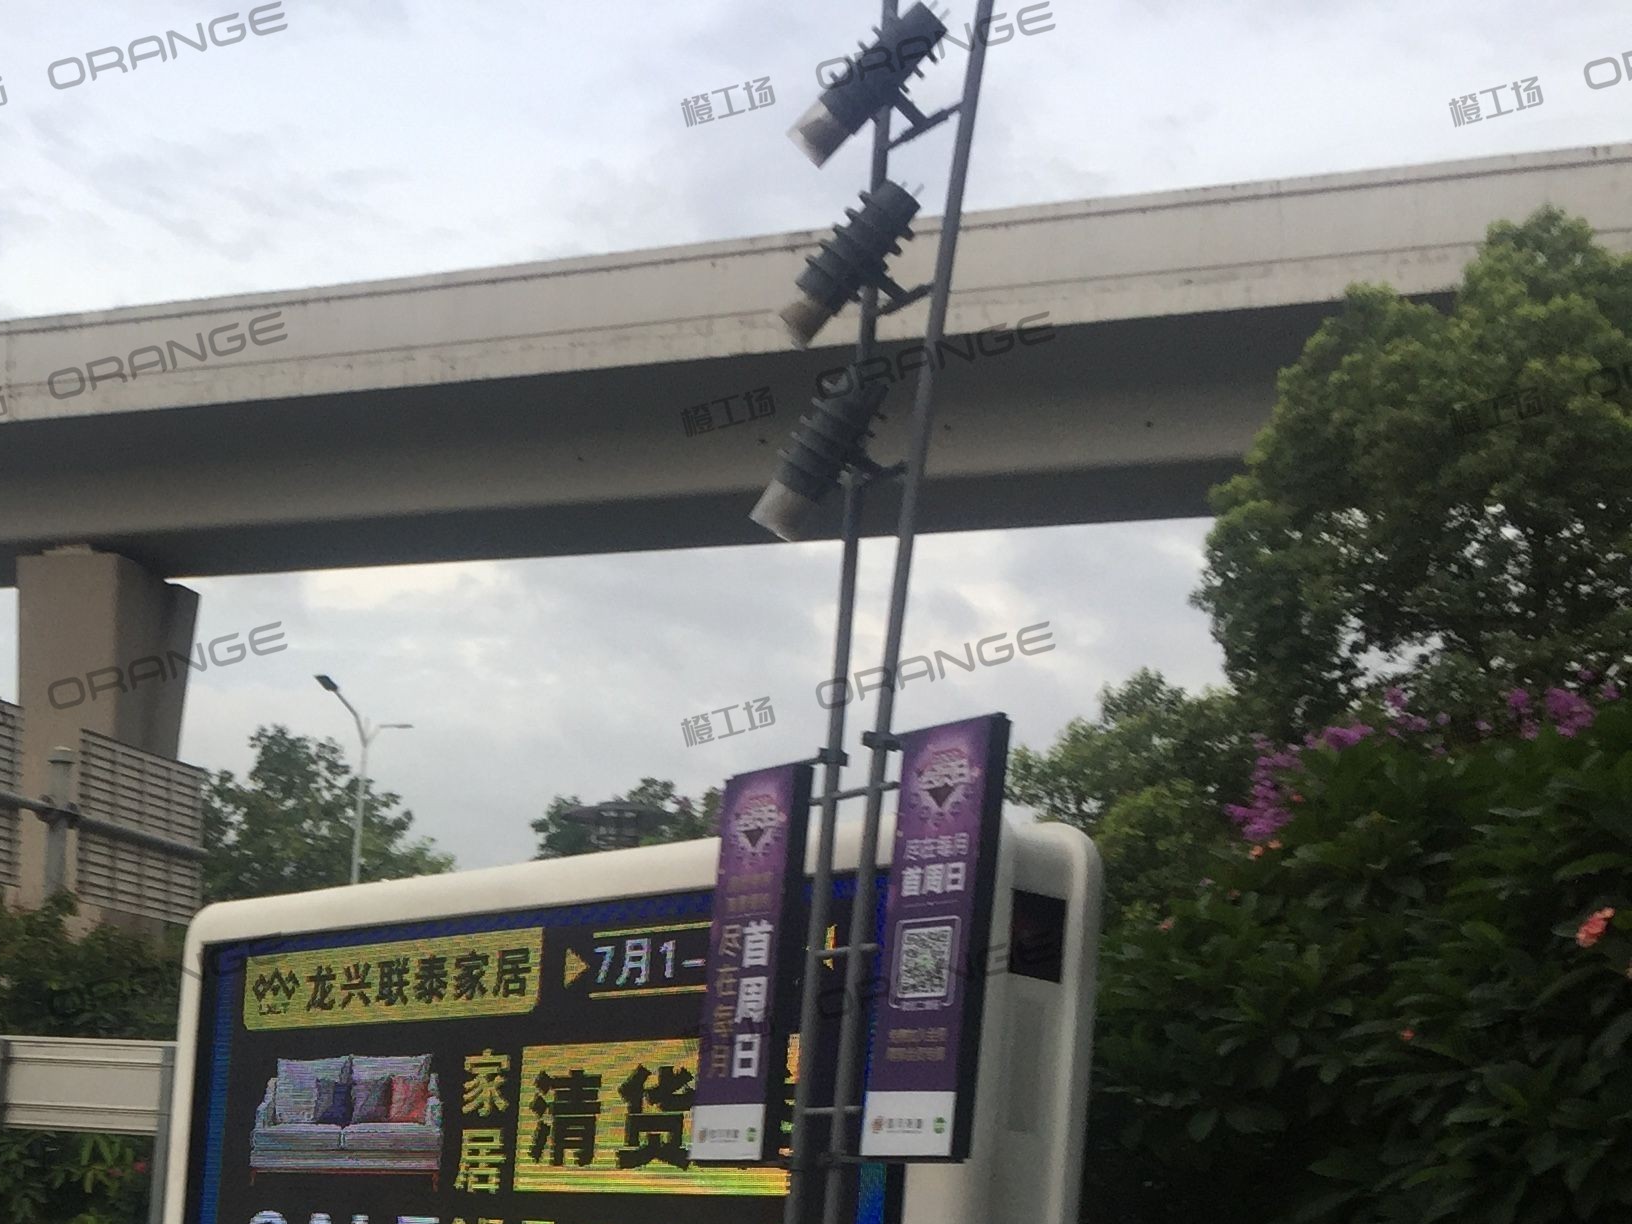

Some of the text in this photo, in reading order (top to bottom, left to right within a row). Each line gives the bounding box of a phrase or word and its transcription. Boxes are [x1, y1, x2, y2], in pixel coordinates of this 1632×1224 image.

[901, 861, 966, 898] 首周日
[306, 948, 532, 1012] 龙兴联泰家居
[732, 919, 774, 1078] 首周日
[455, 1048, 511, 1194] 家居
[530, 1064, 701, 1171] 清货
